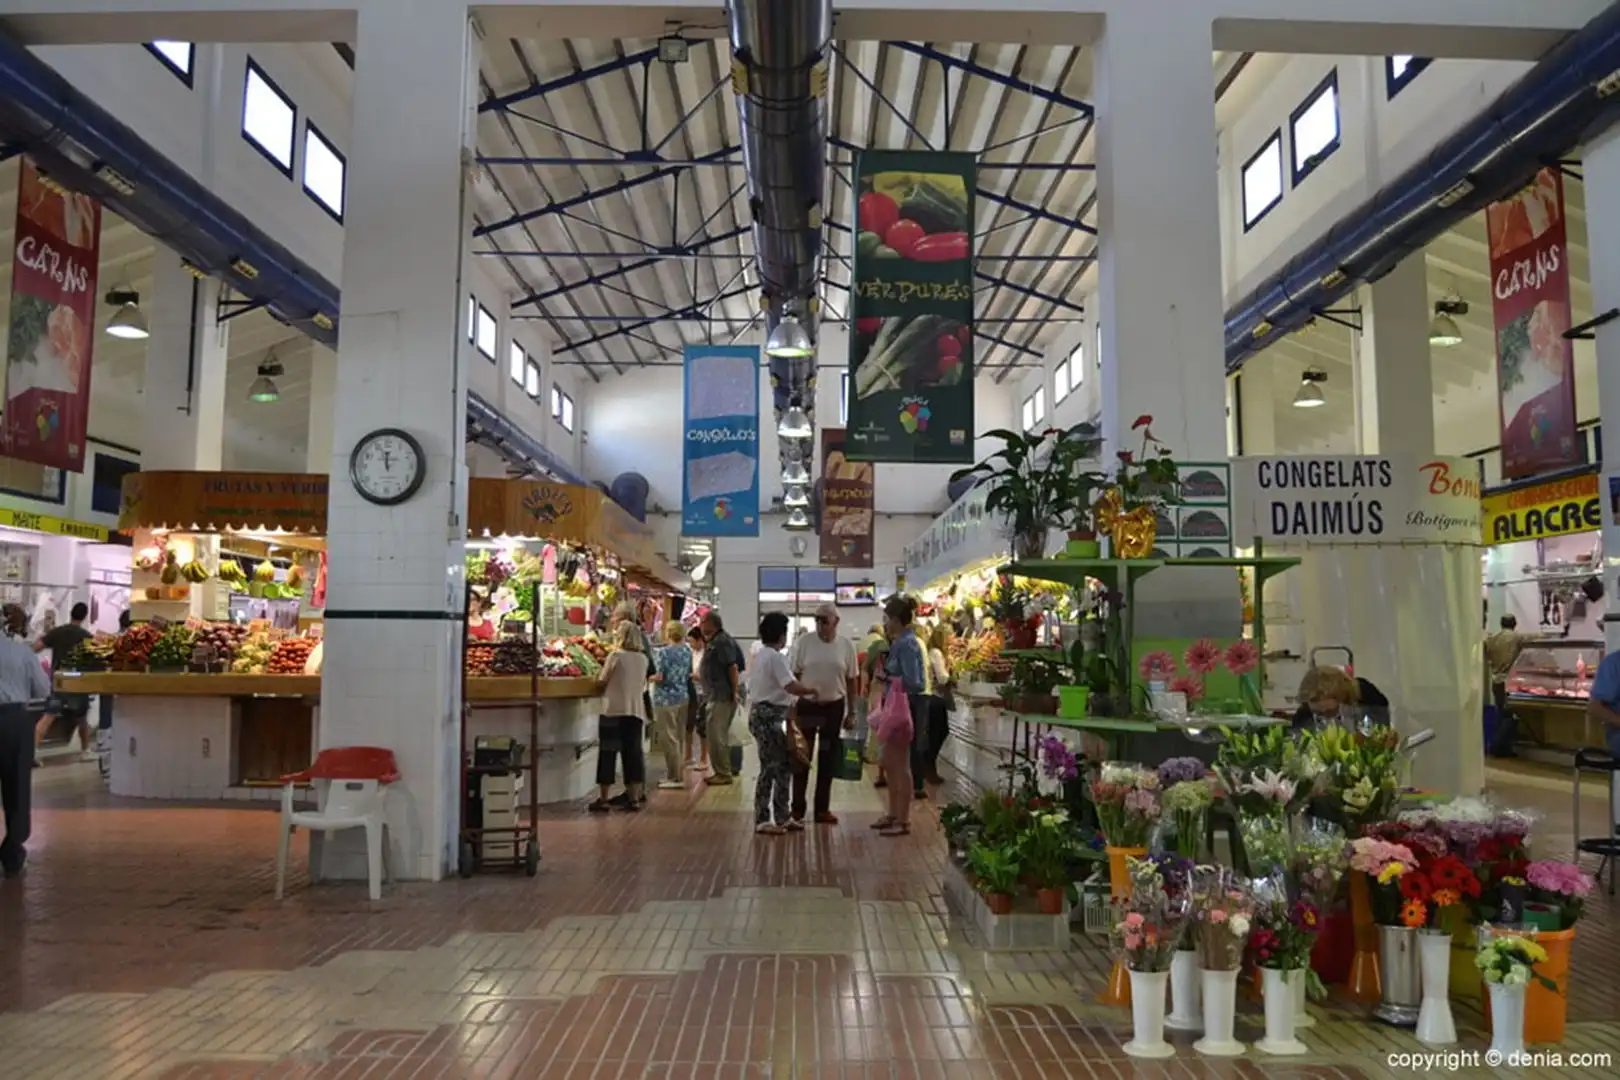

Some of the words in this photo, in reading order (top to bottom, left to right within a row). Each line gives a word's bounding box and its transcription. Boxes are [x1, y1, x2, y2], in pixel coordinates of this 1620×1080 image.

[16, 236, 88, 293] CARNS
[1495, 244, 1560, 299] CARNS
[854, 277, 971, 304] VERDURES
[203, 478, 261, 494] FRUTAS
[264, 478, 275, 494] Y
[1258, 460, 1392, 489] CONGELATS
[1271, 491, 1384, 535] DAIMÚS
[1493, 497, 1601, 541] ALACRE
